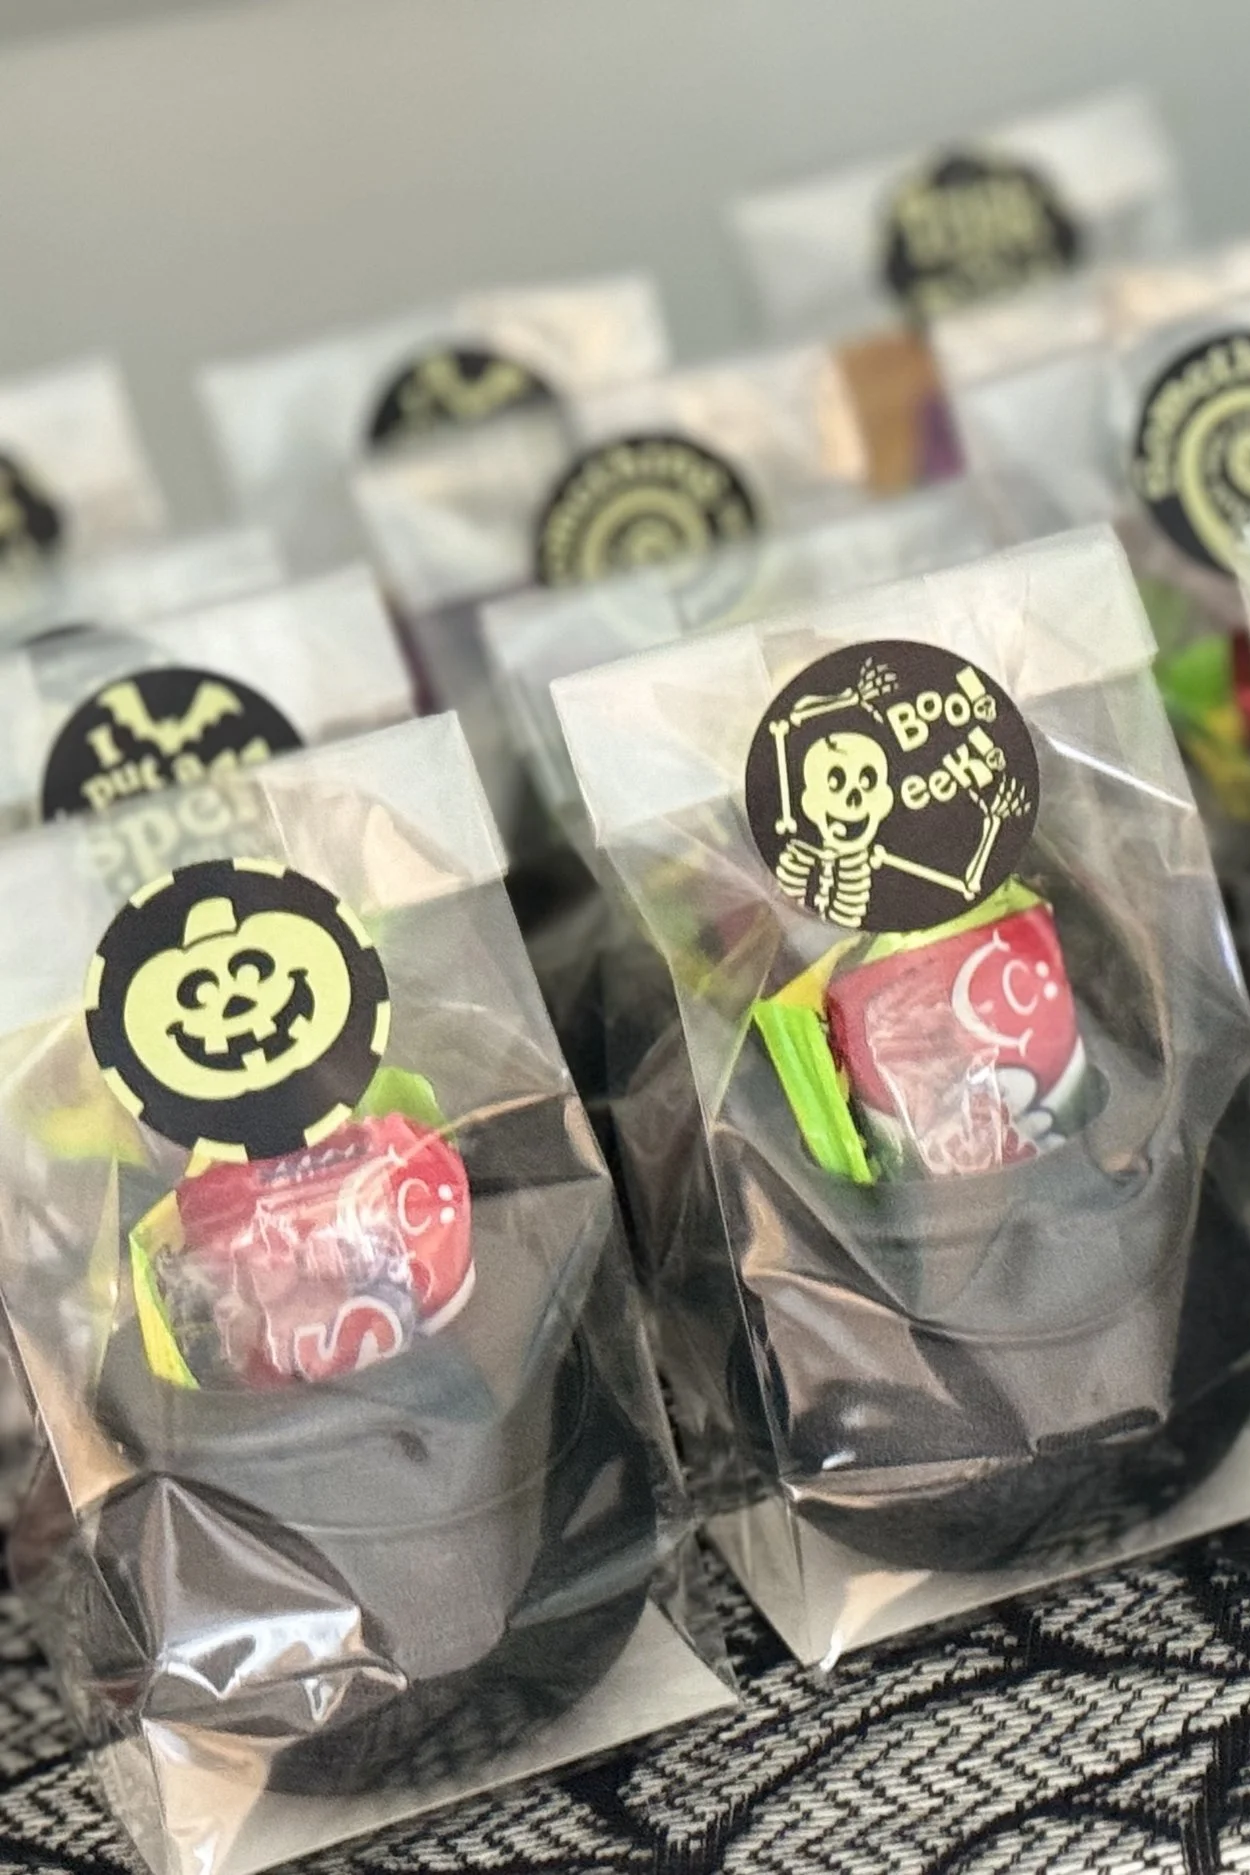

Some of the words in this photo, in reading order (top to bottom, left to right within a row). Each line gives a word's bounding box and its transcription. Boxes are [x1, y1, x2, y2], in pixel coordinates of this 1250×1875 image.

[85, 723, 124, 768] I
[80, 755, 166, 811] put
[170, 751, 203, 786] a
